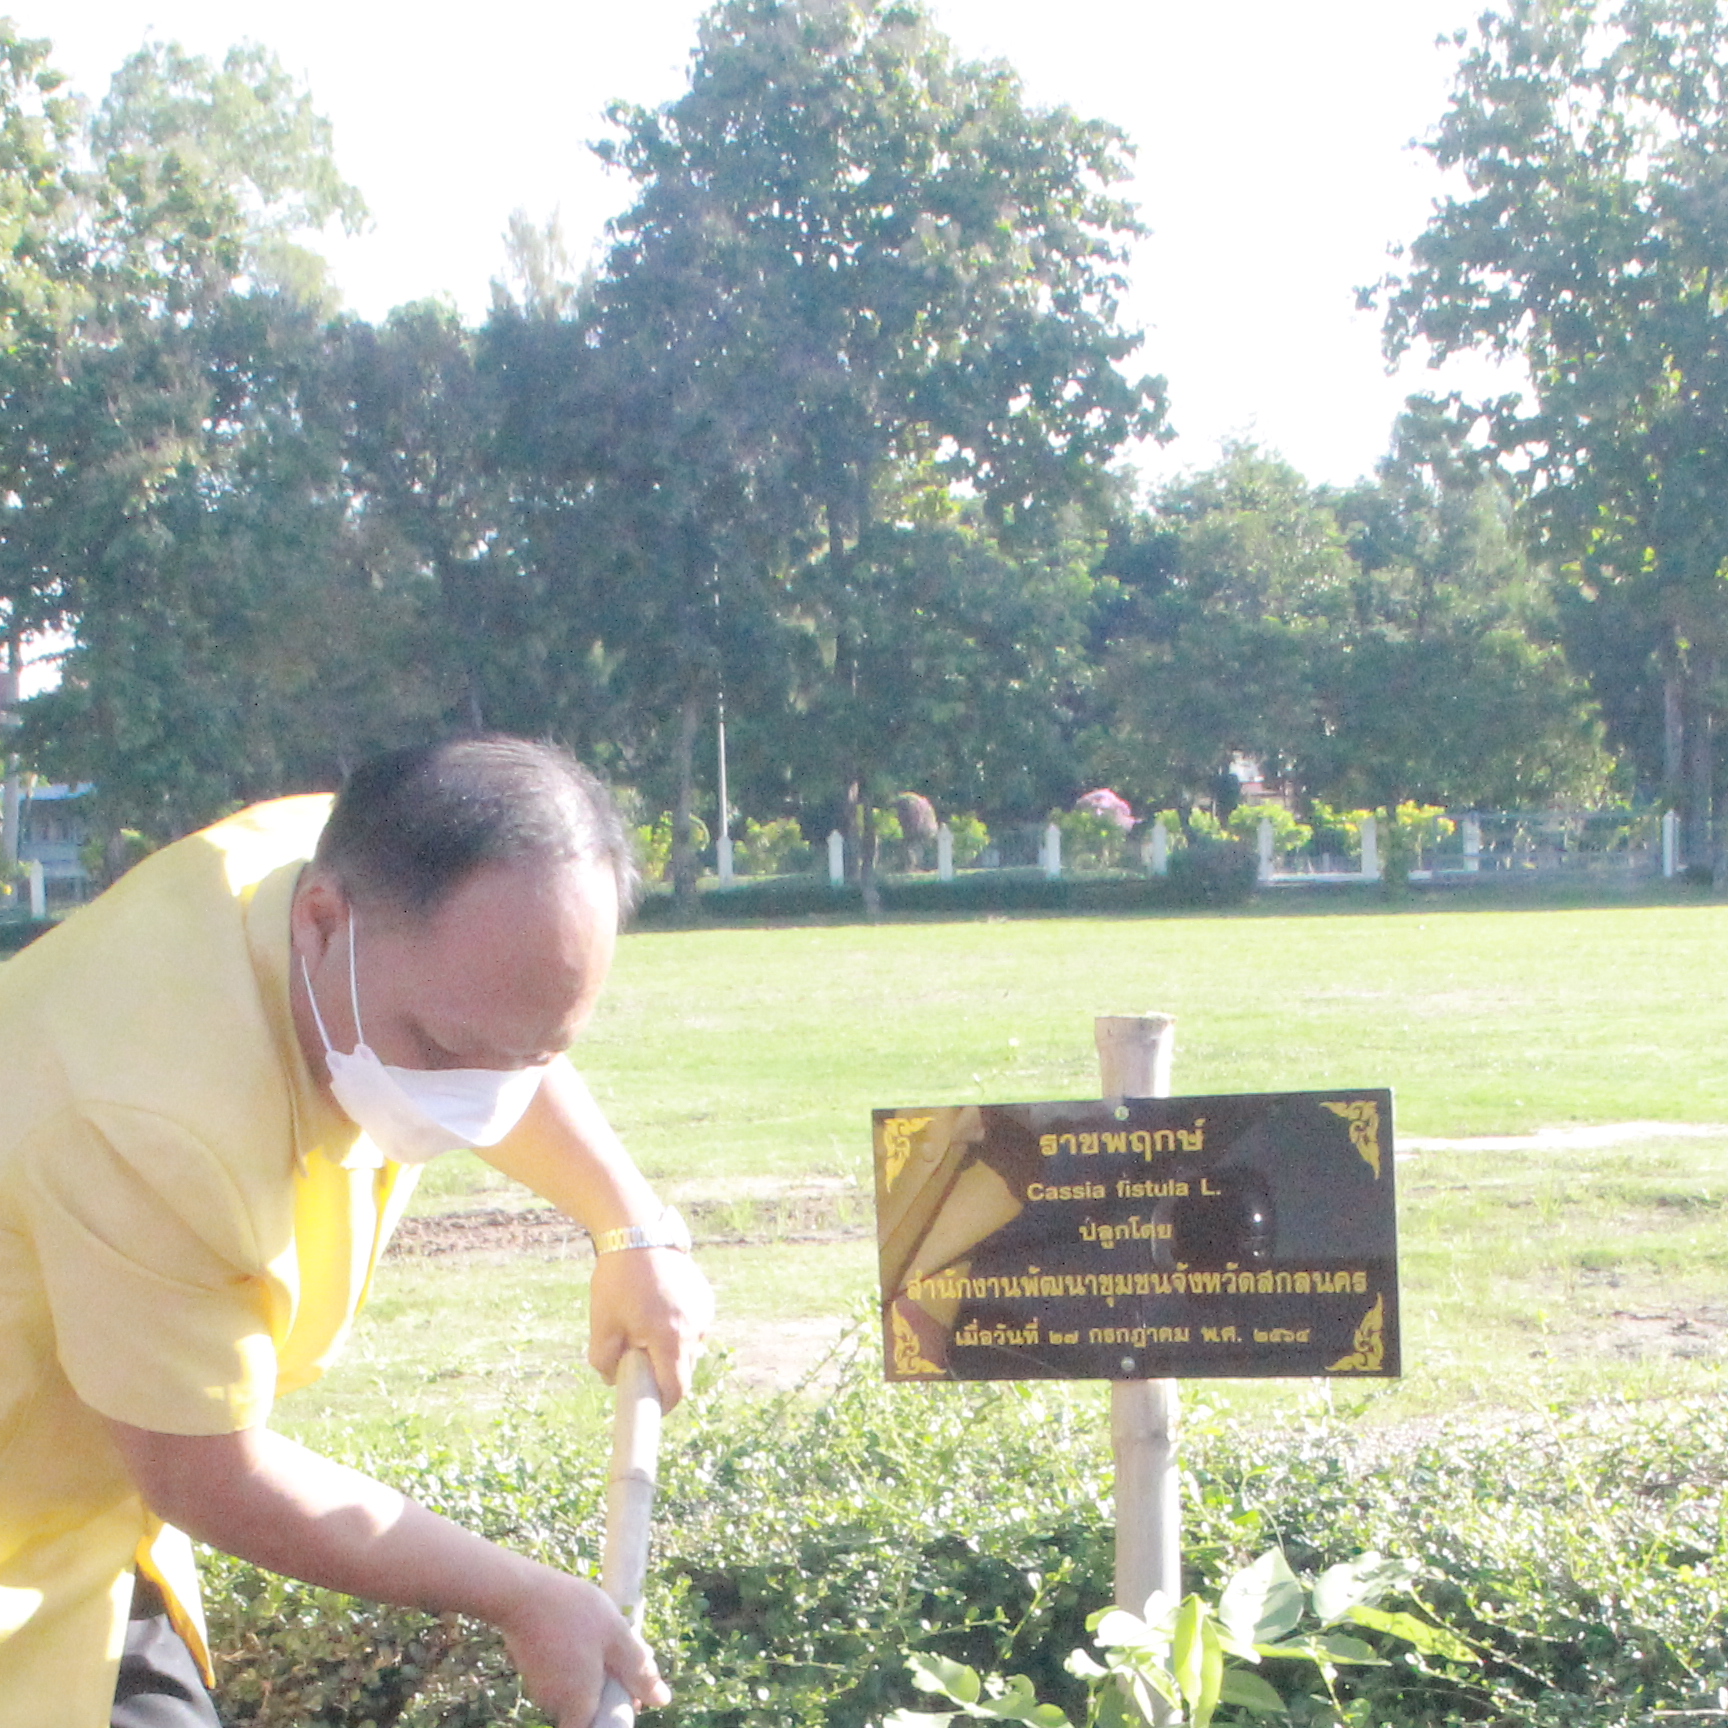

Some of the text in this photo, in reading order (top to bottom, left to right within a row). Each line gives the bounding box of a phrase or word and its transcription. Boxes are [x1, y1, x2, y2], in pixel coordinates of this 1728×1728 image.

[1039, 1118, 1207, 1162] ราชพฤกษ์
[1027, 1178, 1222, 1201] Cassia fistula L.
[1078, 1215, 1173, 1250] ปลูกโดย
[906, 1261, 1368, 1308] สำนักงานพัฒนาชุมชนจังหวัดสกลนคร
[955, 1316, 1040, 1346] เมื่อวันที่
[1089, 1326, 1190, 1348] กรกฎาคม
[1201, 1325, 1243, 1343] พ.ศ.
